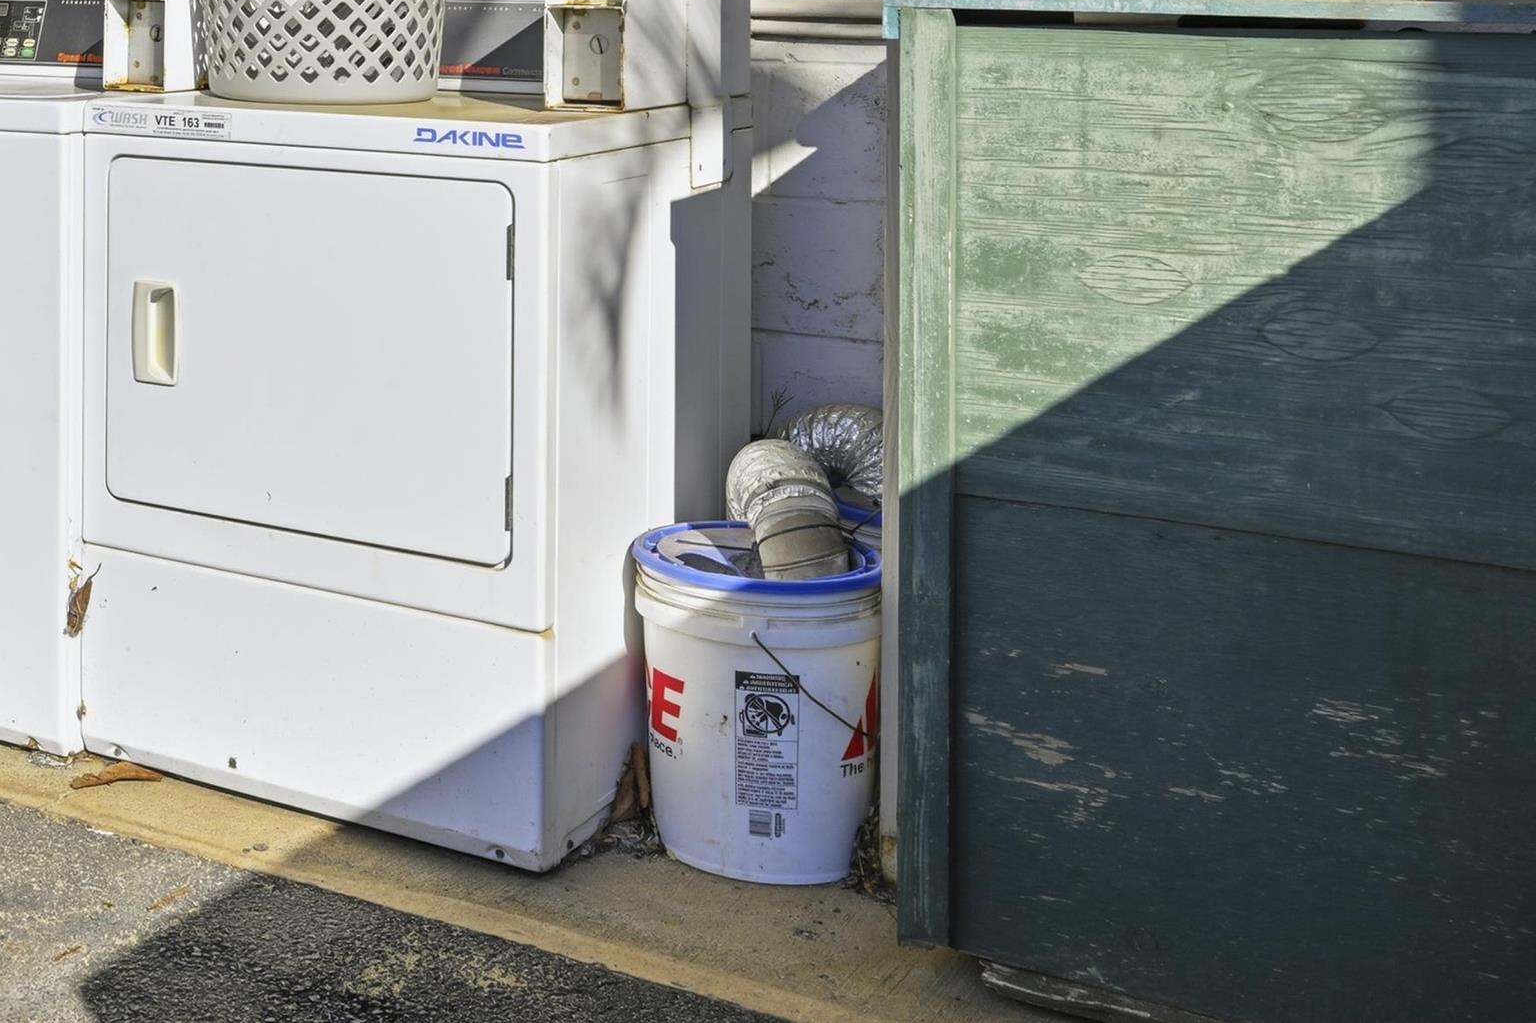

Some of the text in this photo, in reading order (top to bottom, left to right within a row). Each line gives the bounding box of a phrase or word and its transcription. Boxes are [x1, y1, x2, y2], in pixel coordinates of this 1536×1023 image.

[109, 110, 148, 125] WASH
[155, 115, 200, 128] VTE 163
[840, 762, 864, 777] The
